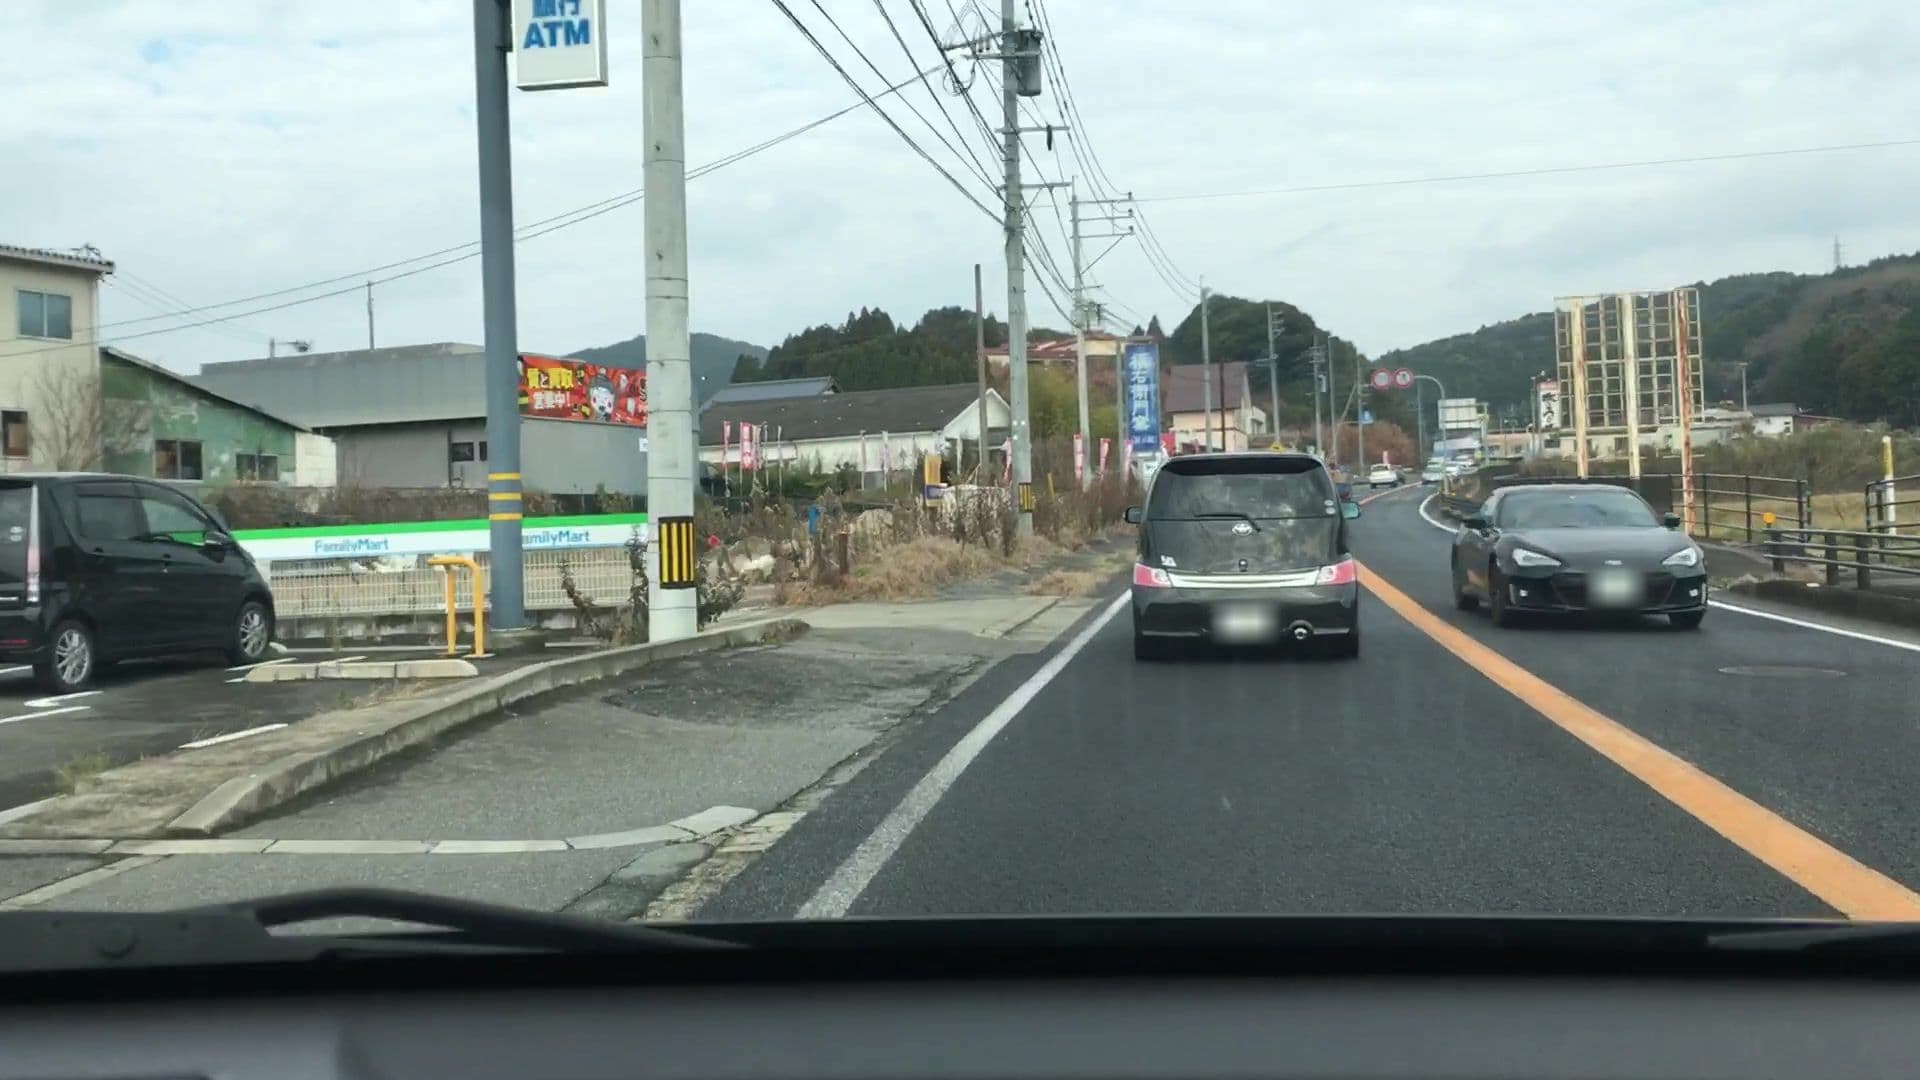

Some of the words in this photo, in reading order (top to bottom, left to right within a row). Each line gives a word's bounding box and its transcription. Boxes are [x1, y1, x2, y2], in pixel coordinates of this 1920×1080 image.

[523, 19, 590, 49] ATM
[314, 537, 389, 552] FamilyMart
[522, 530, 590, 544] amilyMart
